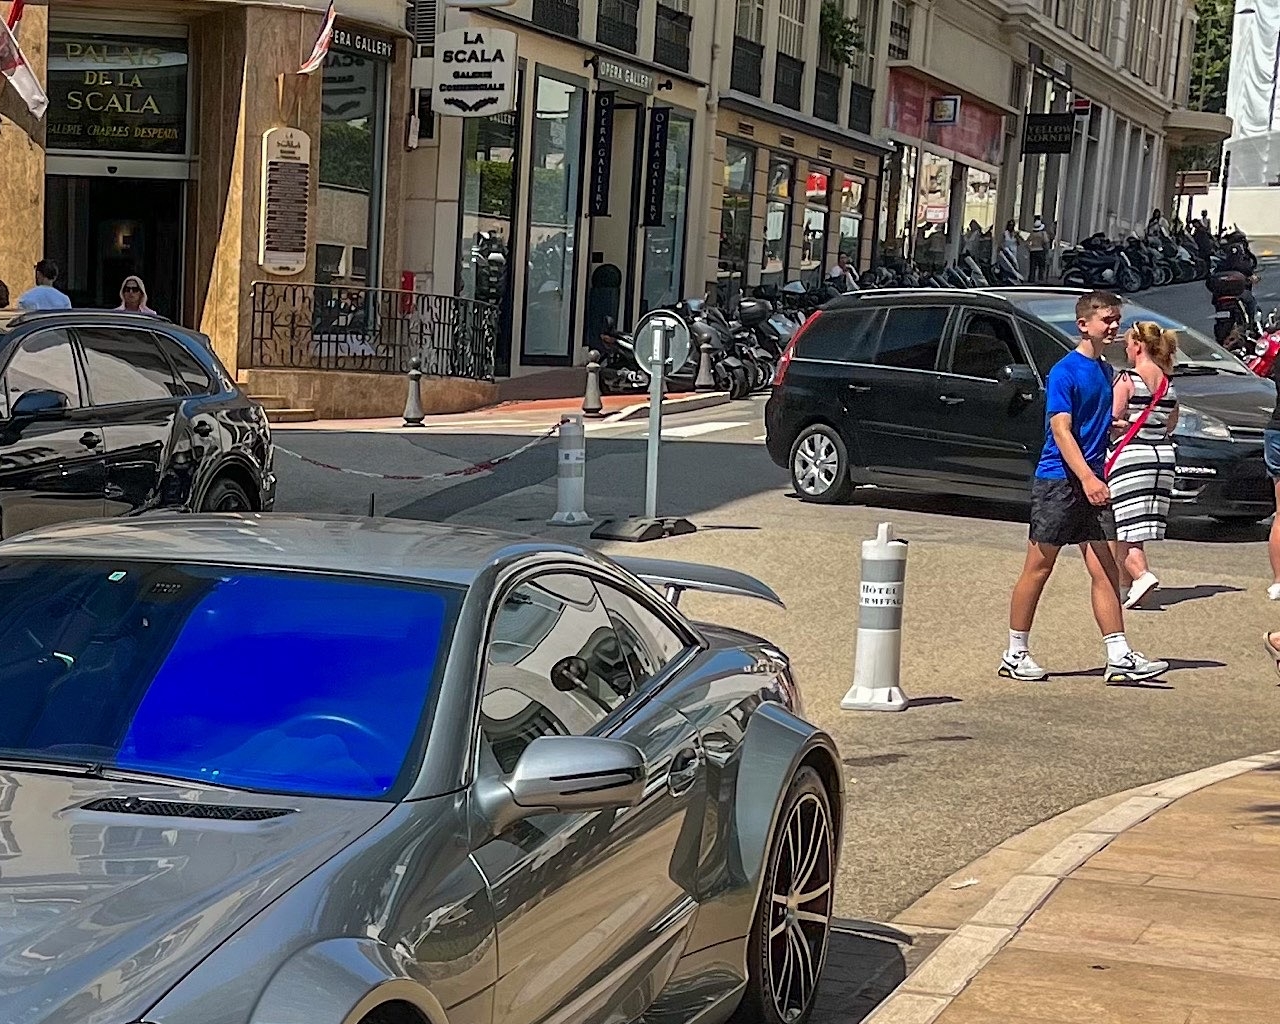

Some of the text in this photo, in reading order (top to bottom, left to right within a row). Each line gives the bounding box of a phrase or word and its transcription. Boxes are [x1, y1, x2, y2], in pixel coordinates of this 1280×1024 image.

[355, 35, 393, 57] GALLERY
[463, 31, 484, 45] LA
[65, 43, 163, 66] PALAIS
[442, 48, 505, 63] SCALA
[84, 71, 143, 88] DE LA
[600, 61, 653, 89] OPERA GALLERY
[66, 91, 161, 115] SCALA
[87, 124, 129, 138] CHARLES
